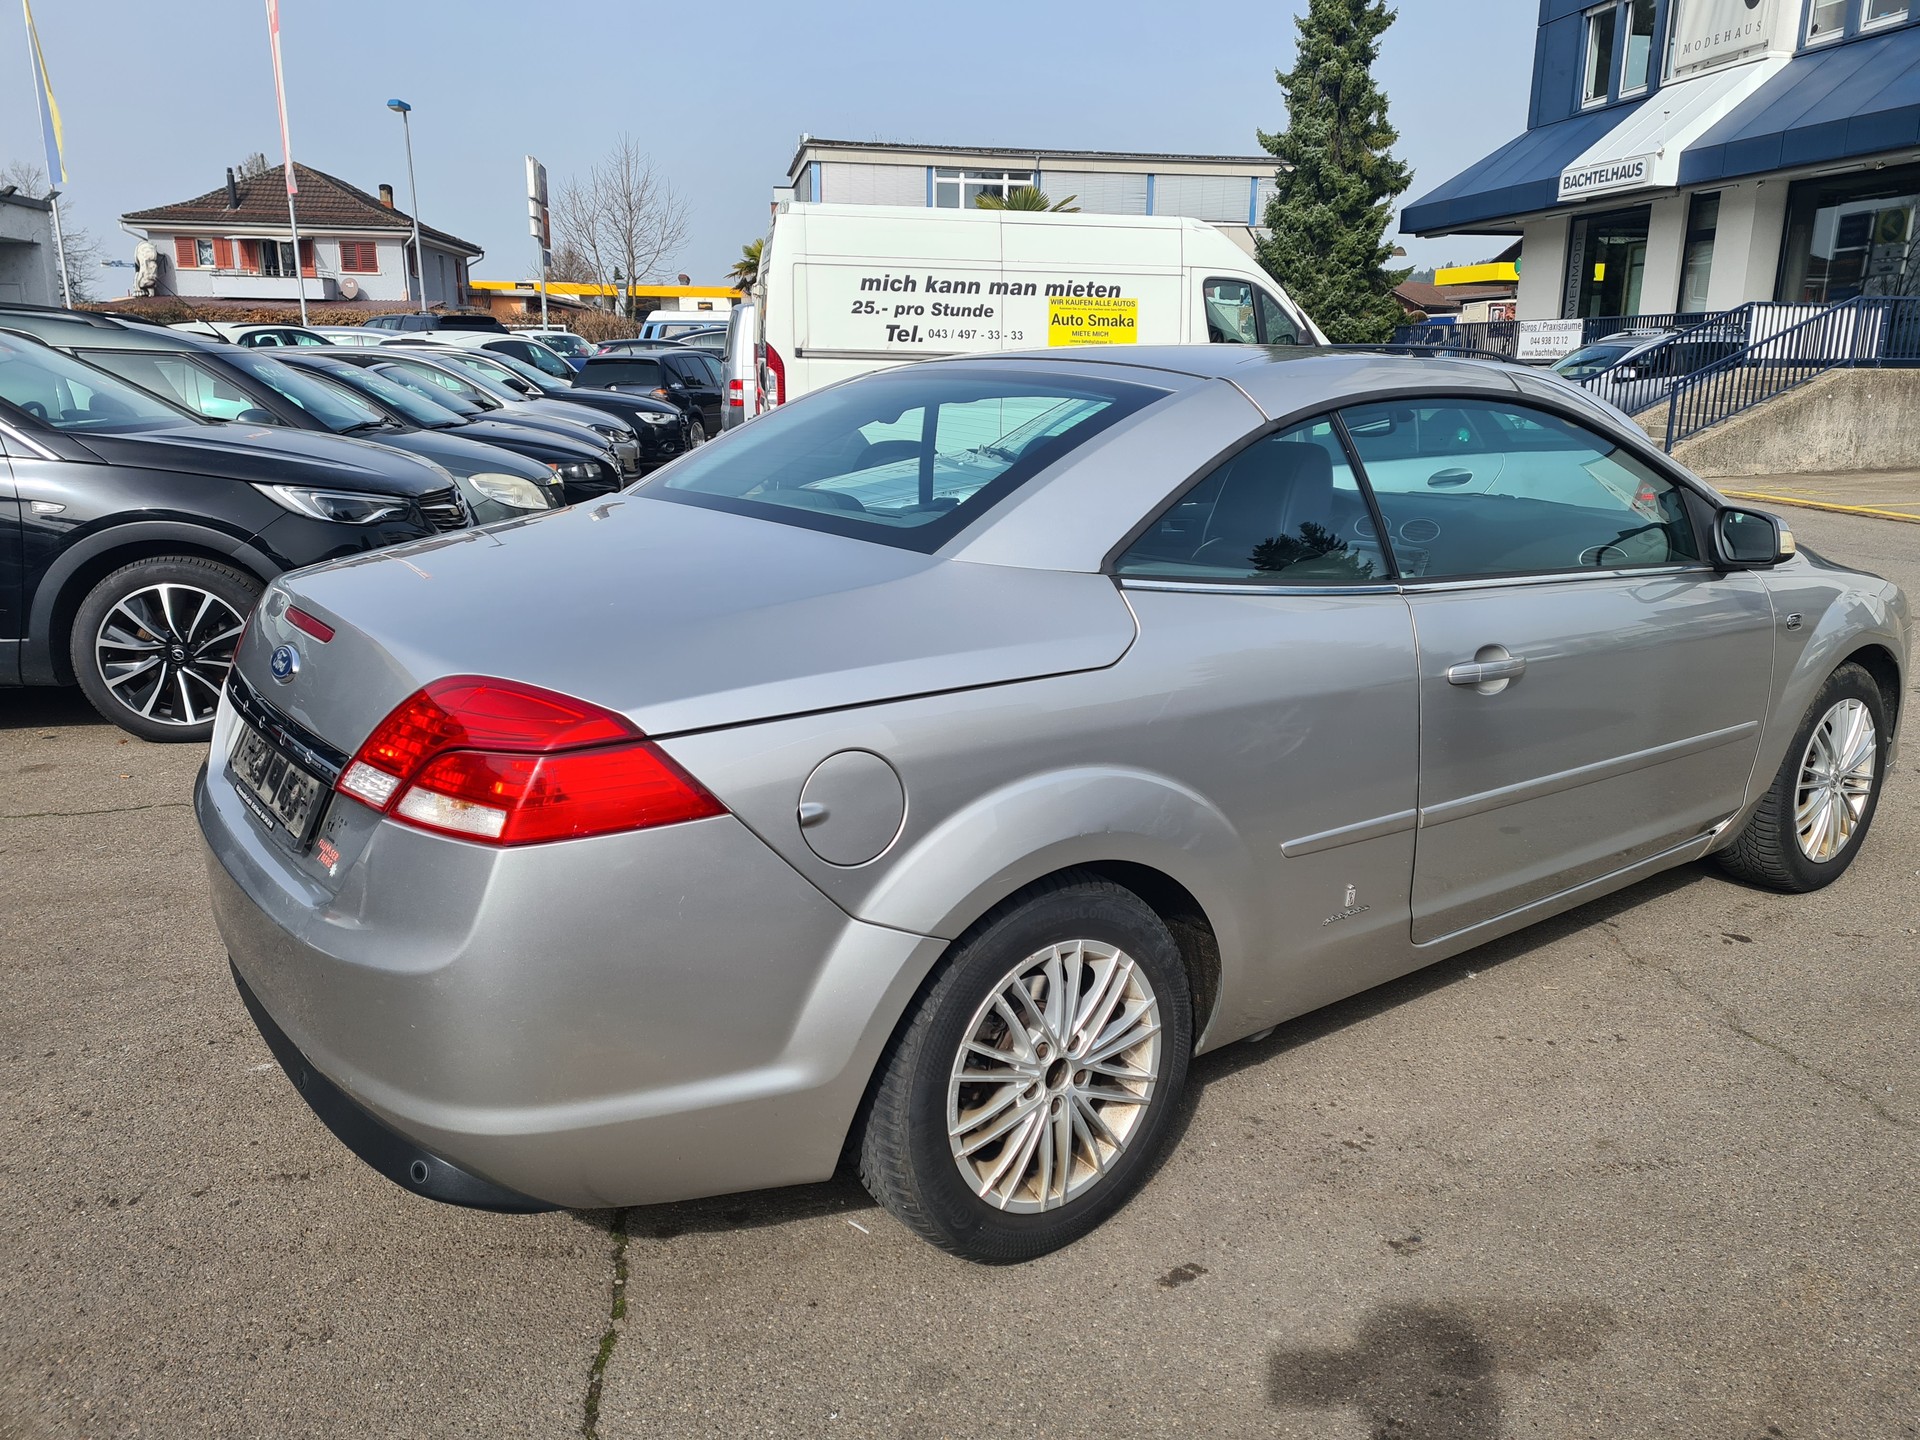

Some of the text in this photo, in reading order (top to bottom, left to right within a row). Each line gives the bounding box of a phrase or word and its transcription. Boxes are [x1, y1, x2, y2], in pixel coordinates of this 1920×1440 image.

[1682, 20, 1762, 55] MODEHAUS
[1563, 161, 1643, 190] BACHTELHAUS
[1567, 231, 1584, 319] AMENMODE
[860, 273, 1122, 299] mich kann man mieten
[850, 300, 995, 319] 25.- pro Stunde
[1065, 299, 1094, 307] KAUFEN
[1113, 300, 1136, 308] AUTOS
[1051, 313, 1135, 328] Auto Smaka
[1520, 323, 1537, 332] Büros
[1542, 321, 1582, 331] Praxisräume
[885, 324, 924, 344] Tel.
[928, 328, 948, 339] 043
[957, 329, 977, 340] 497
[987, 330, 1001, 341] 33
[1010, 331, 1024, 341] 33
[1071, 330, 1109, 338] MIETE MICH
[1530, 335, 1568, 345] 044 938 12 12
